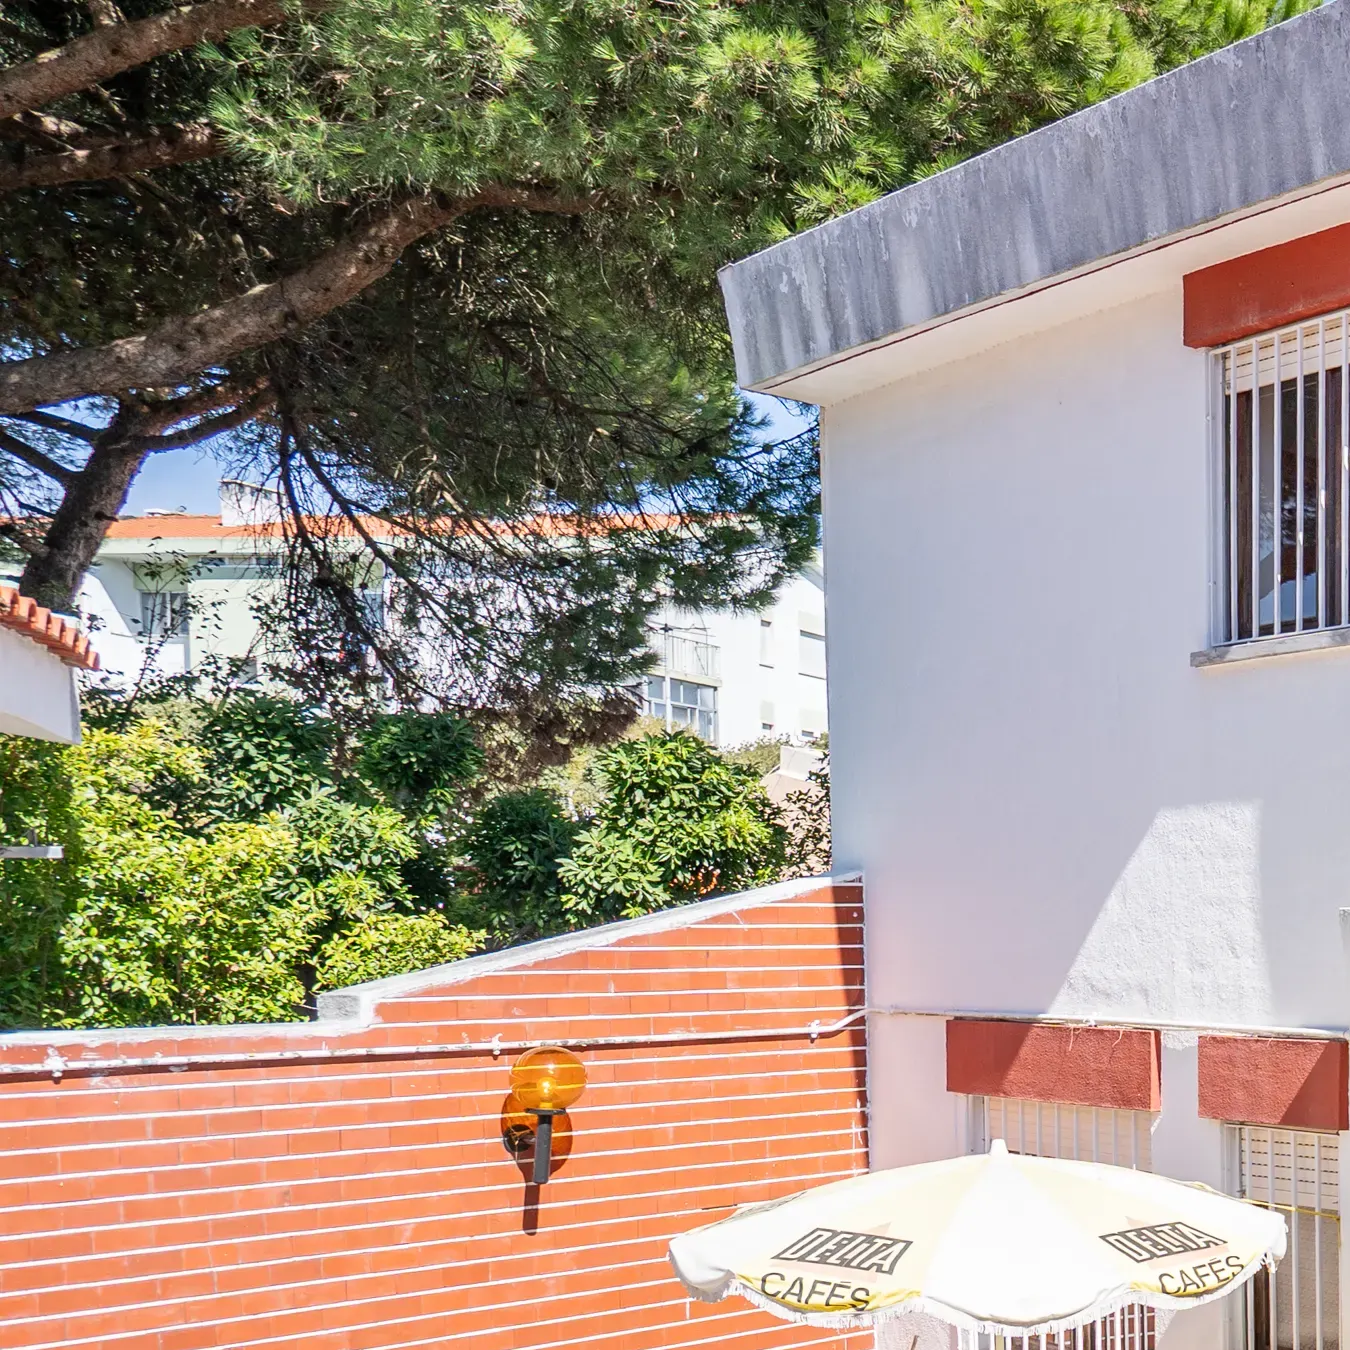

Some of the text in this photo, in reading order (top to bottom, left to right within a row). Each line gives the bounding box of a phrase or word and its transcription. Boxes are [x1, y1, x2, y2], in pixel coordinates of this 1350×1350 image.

[774, 1228, 911, 1274] DELTA
[1101, 1222, 1226, 1262] DELTA
[760, 1272, 870, 1311] CAFÉS
[1158, 1255, 1245, 1295] CAFÉS
